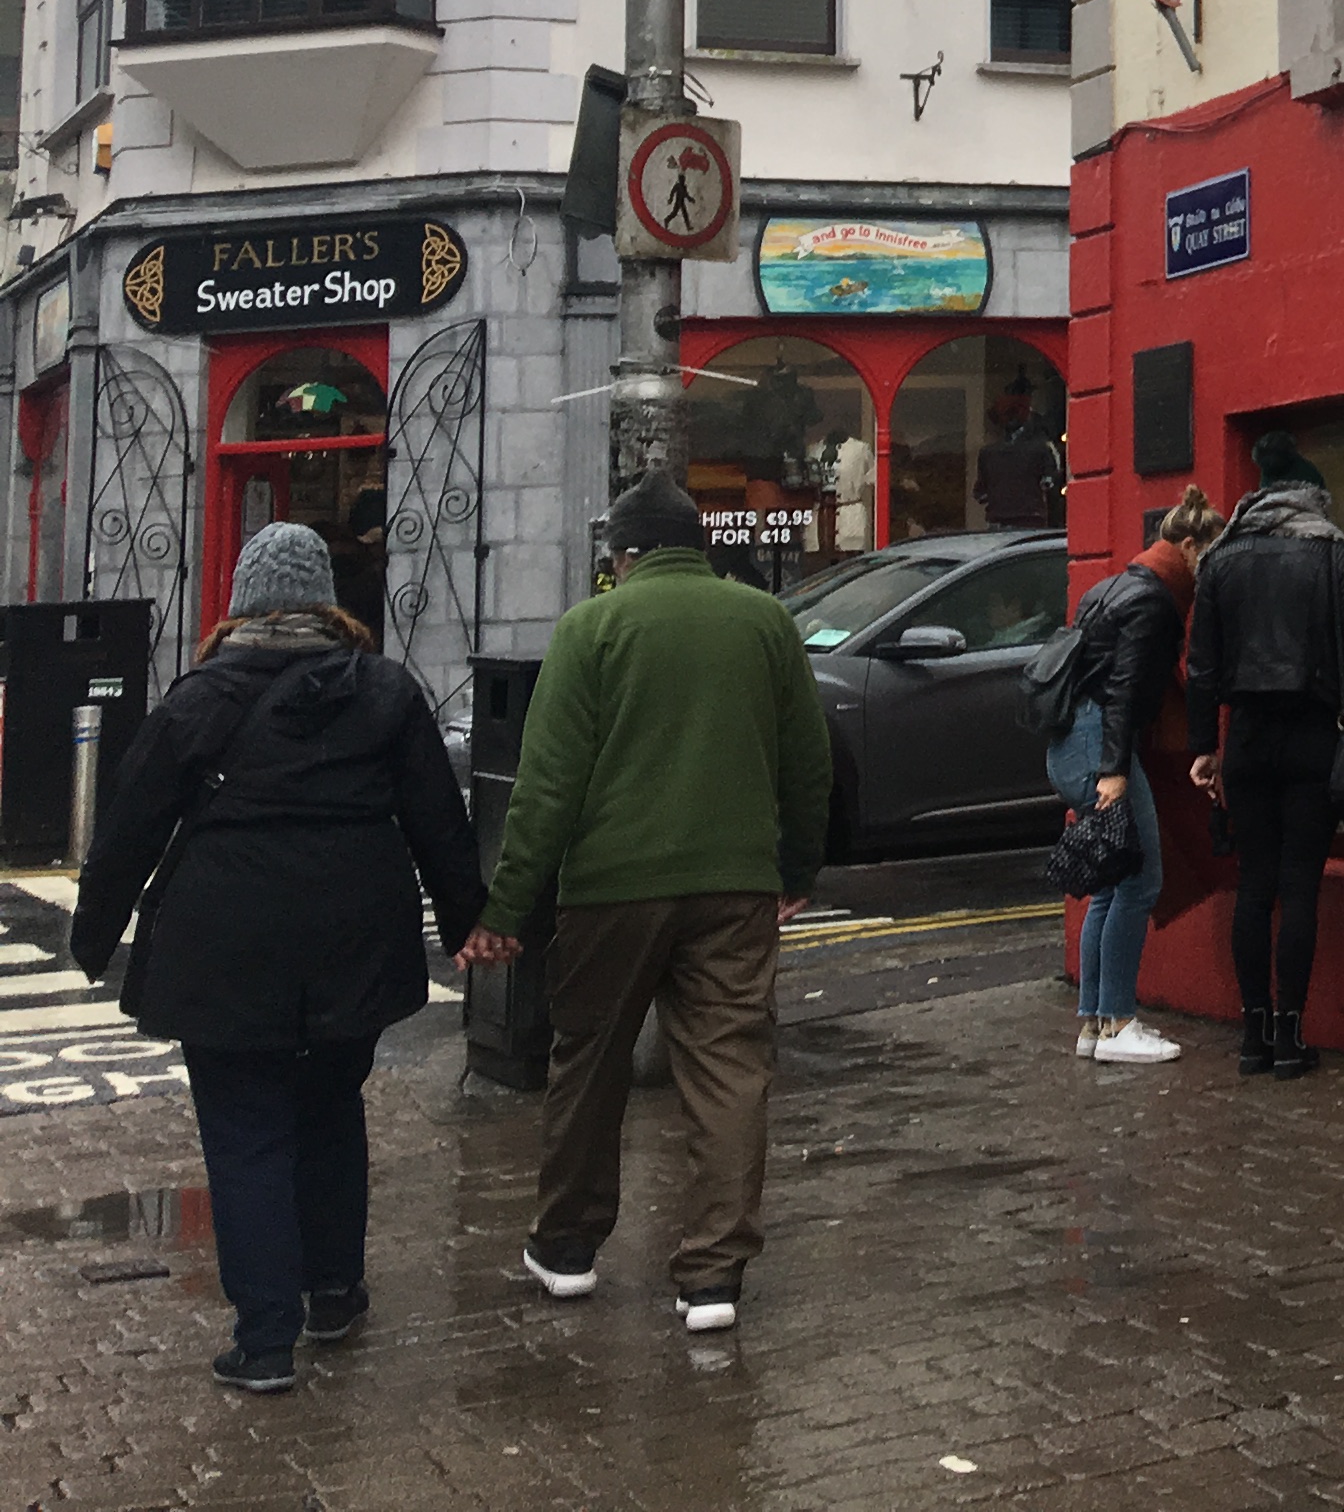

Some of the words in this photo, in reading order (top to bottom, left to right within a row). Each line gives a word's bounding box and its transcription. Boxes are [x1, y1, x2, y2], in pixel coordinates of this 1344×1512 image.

[812, 226, 837, 245] and
[840, 227, 856, 242] go
[859, 225, 871, 238] to
[1185, 228, 1209, 255] QUAY
[1213, 218, 1246, 244] STREET
[213, 231, 380, 271] FALLER'S
[196, 279, 320, 313] Sweater
[324, 270, 396, 308] Shop
[699, 510, 757, 527] HIRTS
[766, 509, 814, 526] €9.95
[711, 528, 751, 546] FOR
[760, 527, 791, 544] €18
